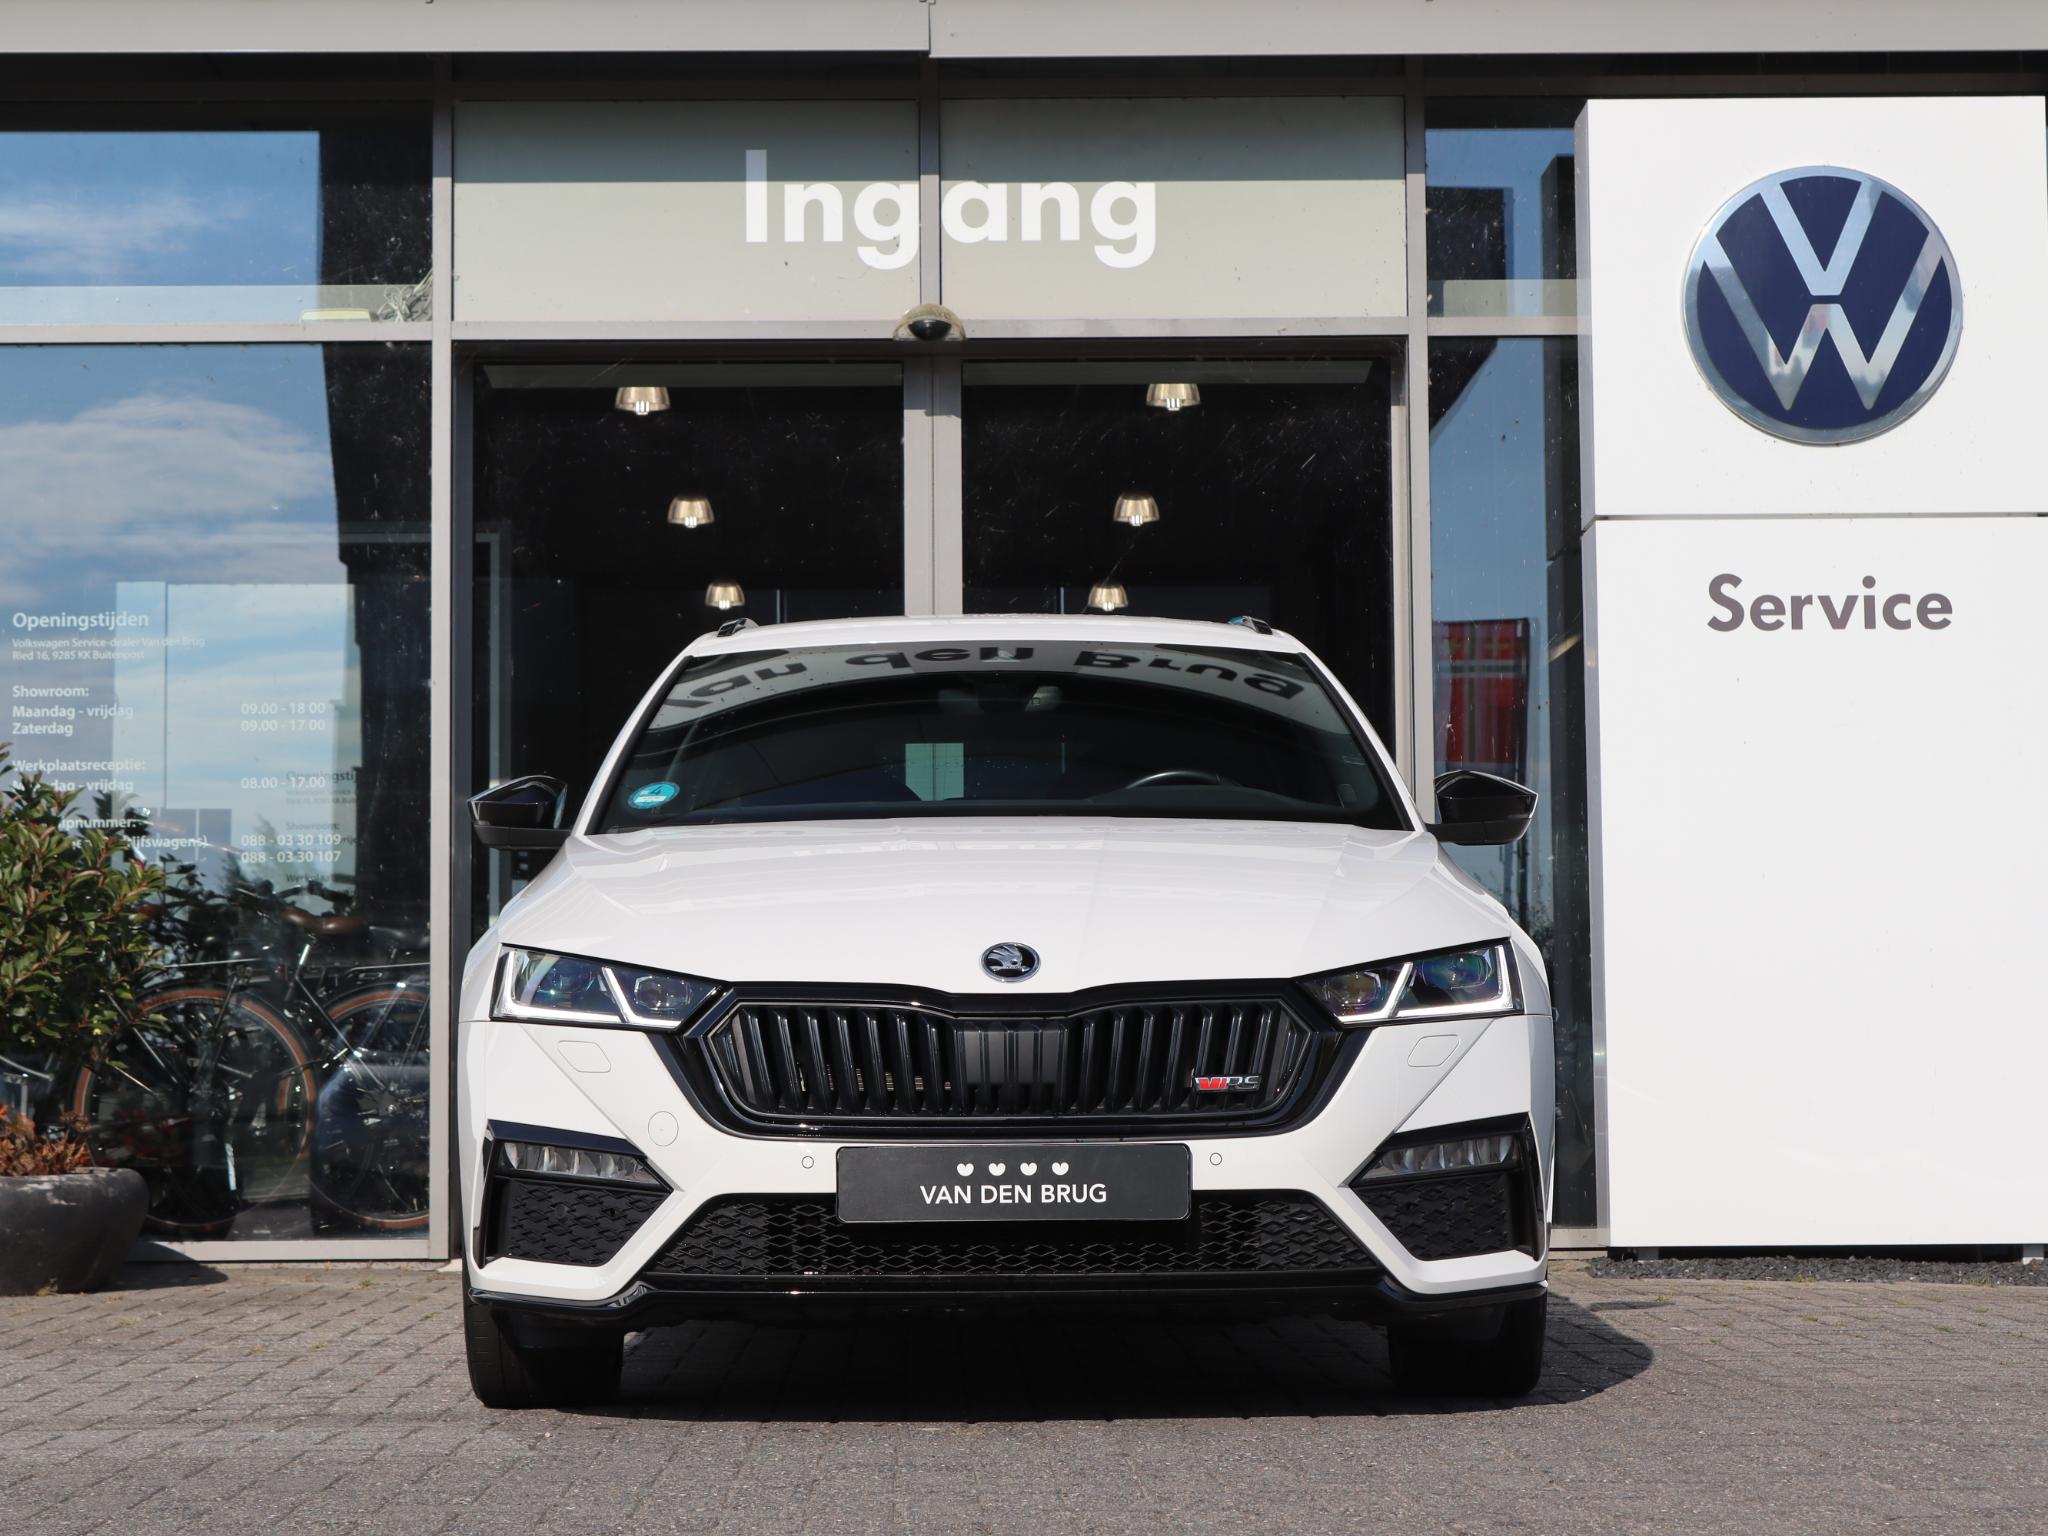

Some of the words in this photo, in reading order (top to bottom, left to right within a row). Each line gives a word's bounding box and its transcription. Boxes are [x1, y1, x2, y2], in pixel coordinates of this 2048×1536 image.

[745, 149, 1157, 270] Ingang
[1706, 573, 1954, 633] Service
[12, 612, 150, 631] Openingstijden
[12, 638, 70, 649] Volkswagen
[12, 685, 90, 698] Showroom:
[12, 705, 76, 720] Maandag
[86, 704, 134, 720] vrijdag
[241, 703, 278, 714] 09.00
[12, 722, 74, 737] Zaterdag
[241, 720, 278, 732] 09.00
[12, 759, 147, 773] Werkplaatsreceptie:
[86, 778, 134, 793] vrijdag
[241, 777, 278, 789] 08.00
[290, 776, 326, 789] 17.00
[240, 834, 266, 846] 088
[277, 834, 293, 846] 03
[296, 833, 313, 846] 30
[318, 833, 342, 846] 109
[240, 851, 266, 863] 088
[277, 851, 293, 863] 03
[296, 850, 313, 863] 30
[318, 850, 342, 862] 107
[920, 1185, 972, 1204] VAN
[980, 1184, 1032, 1204] DEN
[1040, 1183, 1107, 1204] BRUG
